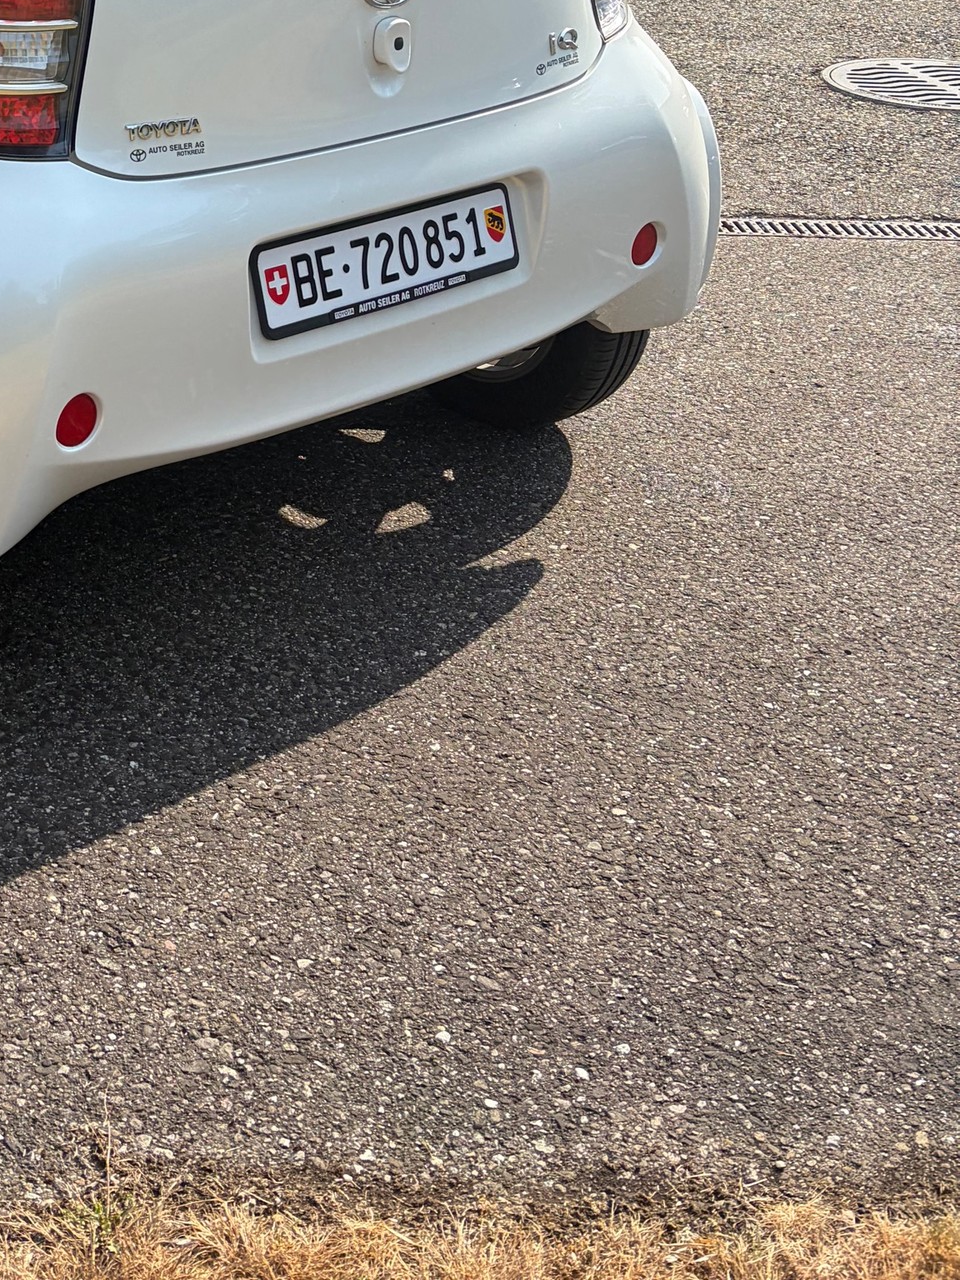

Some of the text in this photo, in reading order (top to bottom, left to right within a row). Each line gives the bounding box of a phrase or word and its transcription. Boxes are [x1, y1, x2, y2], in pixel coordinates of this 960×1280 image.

[549, 27, 579, 56] iQ
[124, 118, 202, 141] TOYOTA
[148, 140, 205, 154] AUTO SEILER AG
[176, 148, 205, 157] ROTKREUZ
[359, 300, 377, 314] AUTO
[377, 293, 401, 308] SEILER
[401, 290, 411, 301] AG
[413, 280, 445, 297] ROTKREUZ
